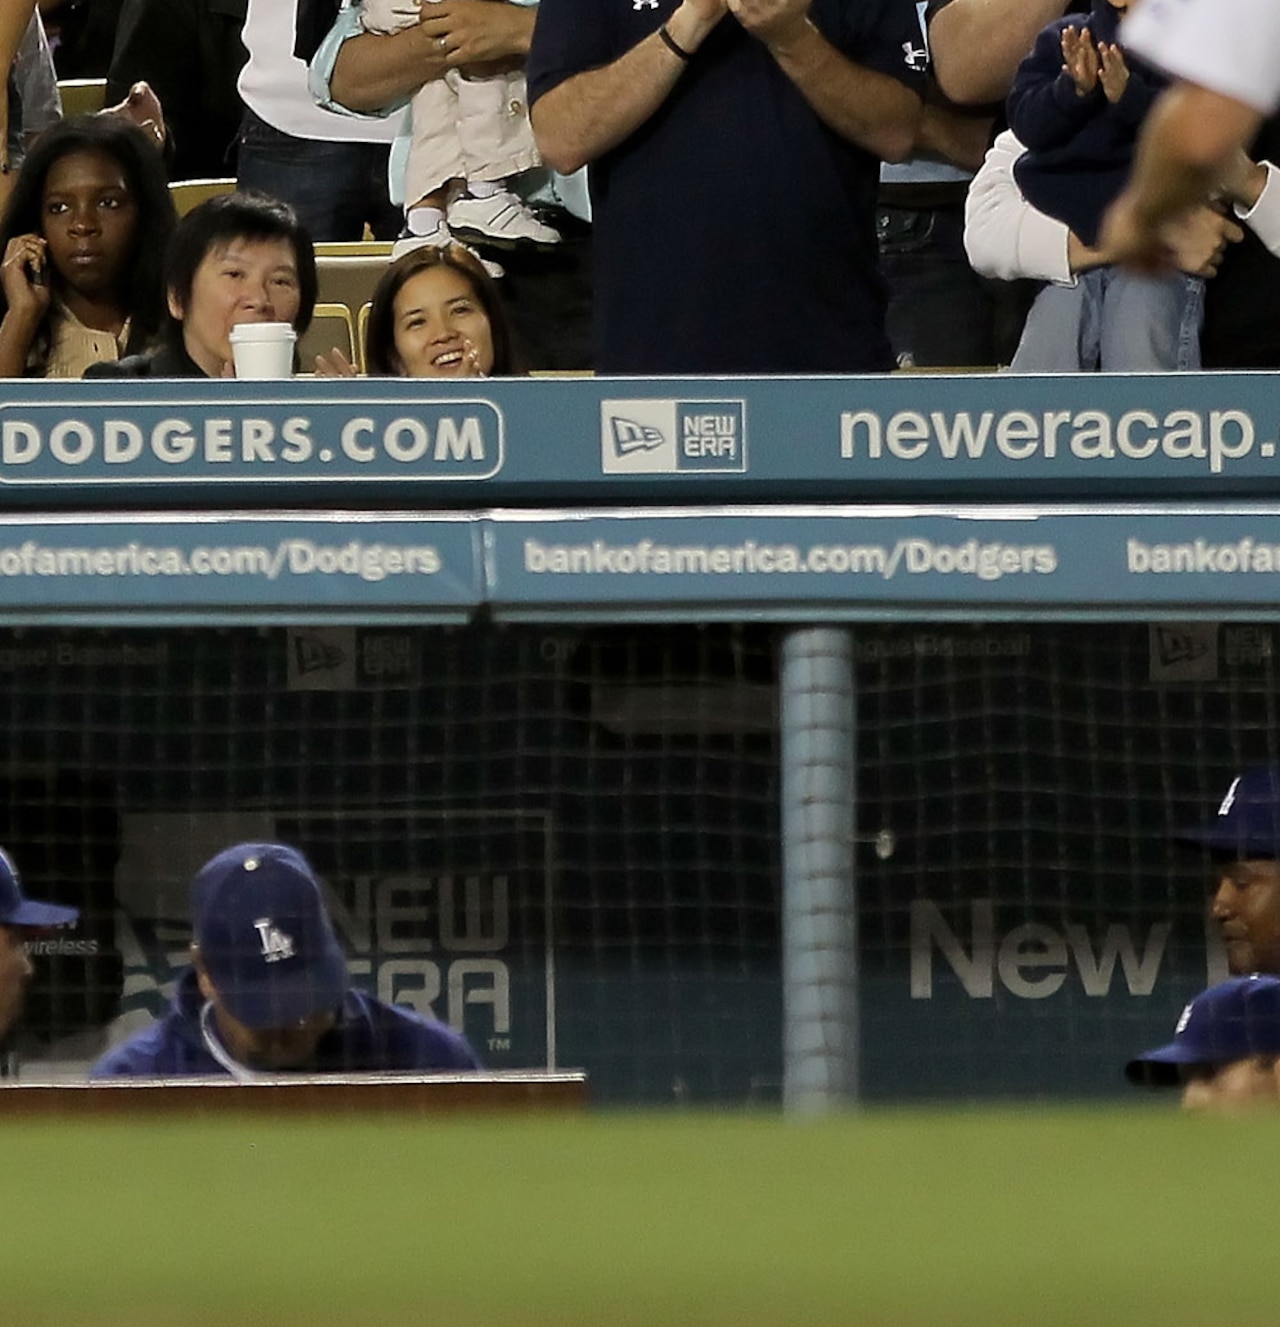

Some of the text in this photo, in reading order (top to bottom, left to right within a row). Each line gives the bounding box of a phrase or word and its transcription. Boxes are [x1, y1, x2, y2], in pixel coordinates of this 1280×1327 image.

[1, 417, 485, 465] DODGERS.COM
[684, 415, 736, 435] NEW
[684, 436, 736, 458] ERA
[523, 537, 1058, 580] bankofamerica.com/Dodgers
[252, 918, 297, 963] LA
[910, 898, 1172, 1000] New
